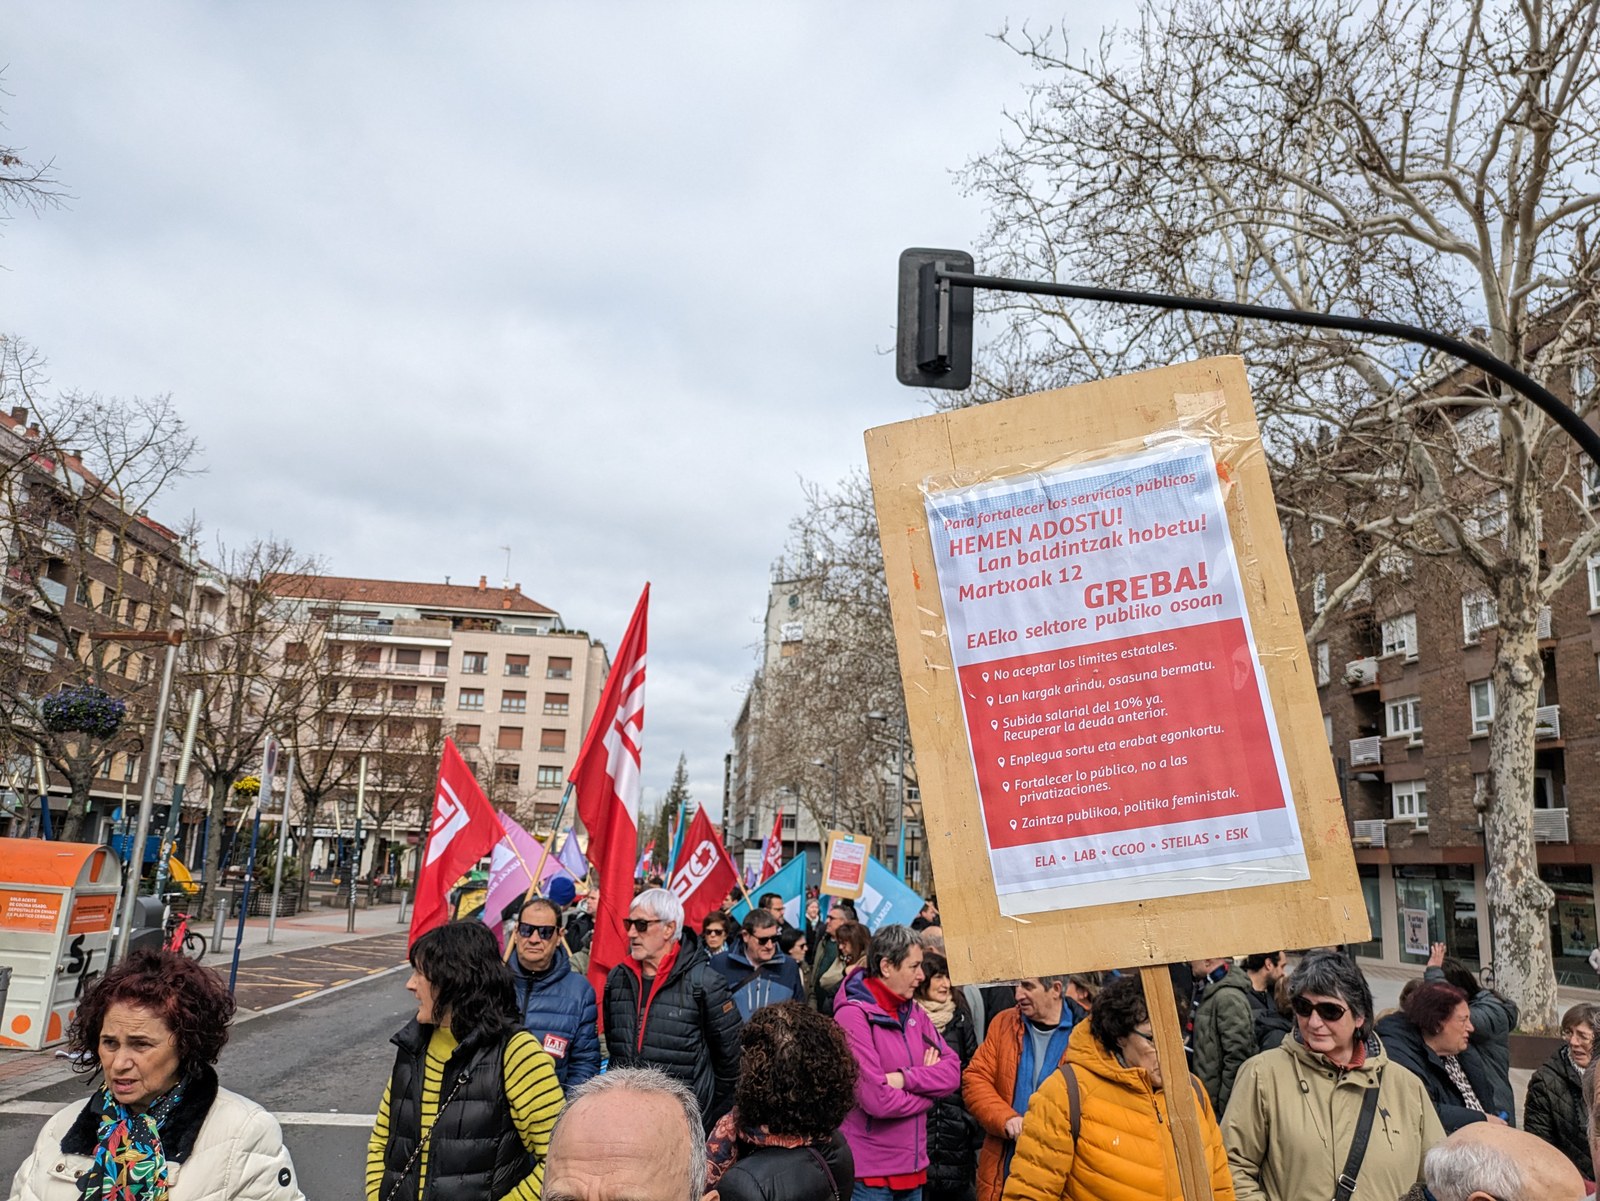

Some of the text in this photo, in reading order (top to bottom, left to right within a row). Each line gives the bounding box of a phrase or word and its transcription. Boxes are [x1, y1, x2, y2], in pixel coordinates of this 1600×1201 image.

[943, 473, 1196, 531] Para fortalecer los servicios públicos
[949, 507, 1123, 557] HEMEN ADOSTU!
[977, 514, 1207, 574] Lan baldintzak hobetu!
[959, 564, 1082, 602] Martxoak 12
[1084, 561, 1208, 609] GREBA!
[966, 593, 1224, 650] EAEko sektore publiko osoan
[994, 641, 1178, 681] No aceptar los límites estatales.
[998, 661, 1215, 705] Lan kargak arindu, osasuna bermatu.
[1002, 695, 1163, 729] Subida salarial del 10% ya.
[1003, 707, 1168, 742] Recuperar la deuda anterior.
[1010, 724, 1226, 767] Enplegua sortu eta erabat egonkortu.
[1014, 755, 1188, 791] Fortalecer lo público, no a las
[1019, 782, 1111, 807] privatizaciones.
[1021, 787, 1239, 829] Zaintza publikoa, politika feministak.
[1034, 828, 1248, 868] ELA LAB CCOO STEILAS ESK
